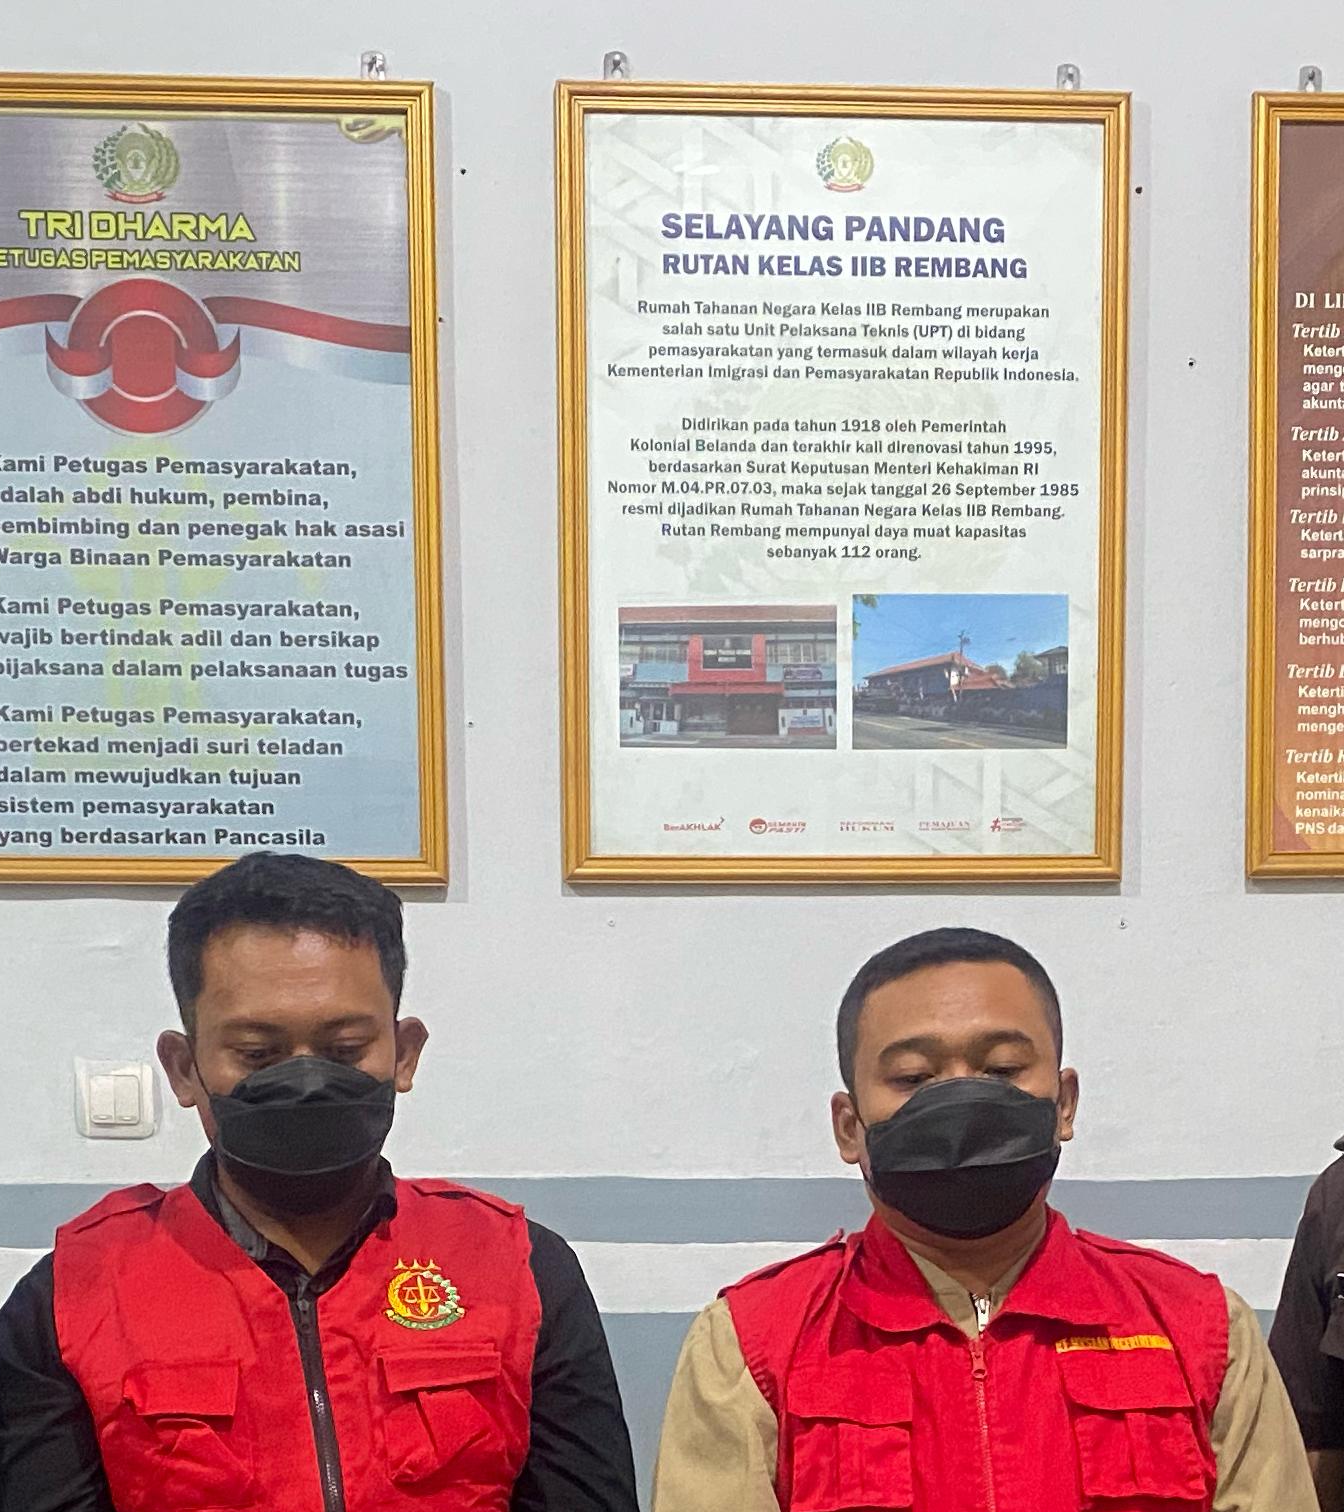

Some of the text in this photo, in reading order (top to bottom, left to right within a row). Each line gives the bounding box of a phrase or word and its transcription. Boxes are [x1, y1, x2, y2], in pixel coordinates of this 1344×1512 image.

[19, 211, 255, 240] TRI DHARMA
[661, 213, 1005, 244] SELAYANG PANDANG
[90, 250, 300, 271] PEMASYARAKATAN
[663, 254, 1027, 279] RUTAN KELAS IIB REMBANG
[638, 300, 1049, 320] Rumah Tahanan Negara Kelas IIB Rembang merupakan
[1295, 292, 1315, 308] DI
[662, 322, 1025, 342] salah satu Unit Pelaksana Teknis (UPT) di bidang
[1292, 323, 1340, 339] Tertib
[649, 344, 1039, 363] pemasyarakatan yang termasuk dalam wilayah kerja
[608, 364, 1079, 383] Kementerian Imigrasi dan Pemasyarakatan Republik Indonesia.
[682, 417, 1006, 434] Didirikan pada tahun 1918 oleh Pemerintah
[1291, 426, 1339, 441] Tertib
[54, 455, 148, 478] Petugas
[156, 457, 356, 479] Pemasyarakatan,
[72, 487, 122, 504] abdi
[130, 487, 215, 509] hukum,
[223, 489, 328, 510] pembina,
[1290, 509, 1338, 524] Tertib
[138, 519, 180, 535] dan
[188, 520, 288, 541] penegak
[295, 520, 337, 537] hak
[344, 521, 404, 537] asasi
[661, 523, 1026, 541] Rutan Rembang mempunyai daya muat kapasitas
[70, 548, 150, 566] Binaan
[158, 549, 351, 571] Pemasyarakatan
[767, 545, 921, 562] sebanyak 112 orang.
[1289, 577, 1337, 593] Tertib
[58, 598, 152, 619] Petugas
[159, 599, 359, 621] Pemasyarakatan,
[61, 628, 173, 646] bertindak
[181, 629, 222, 646] adil
[230, 630, 272, 647] dan
[280, 630, 380, 652] bersikap
[112, 659, 182, 676] dalam
[191, 660, 336, 681] pelaksanaan
[344, 662, 408, 682] tugas
[1287, 663, 1335, 679] Tertib
[61, 706, 155, 727] Petugas
[163, 707, 362, 729] Pemasyarakatan,
[108, 737, 199, 758] menjadi
[206, 738, 249, 754] suri
[257, 738, 343, 755] teladan
[1286, 749, 1333, 764] Tertib
[75, 767, 221, 788] mewujudkan
[229, 768, 301, 789] tujuan
[83, 798, 274, 819] pemasyarakatan
[61, 827, 206, 845] berdasarkan
[214, 828, 325, 846] Pancasila
